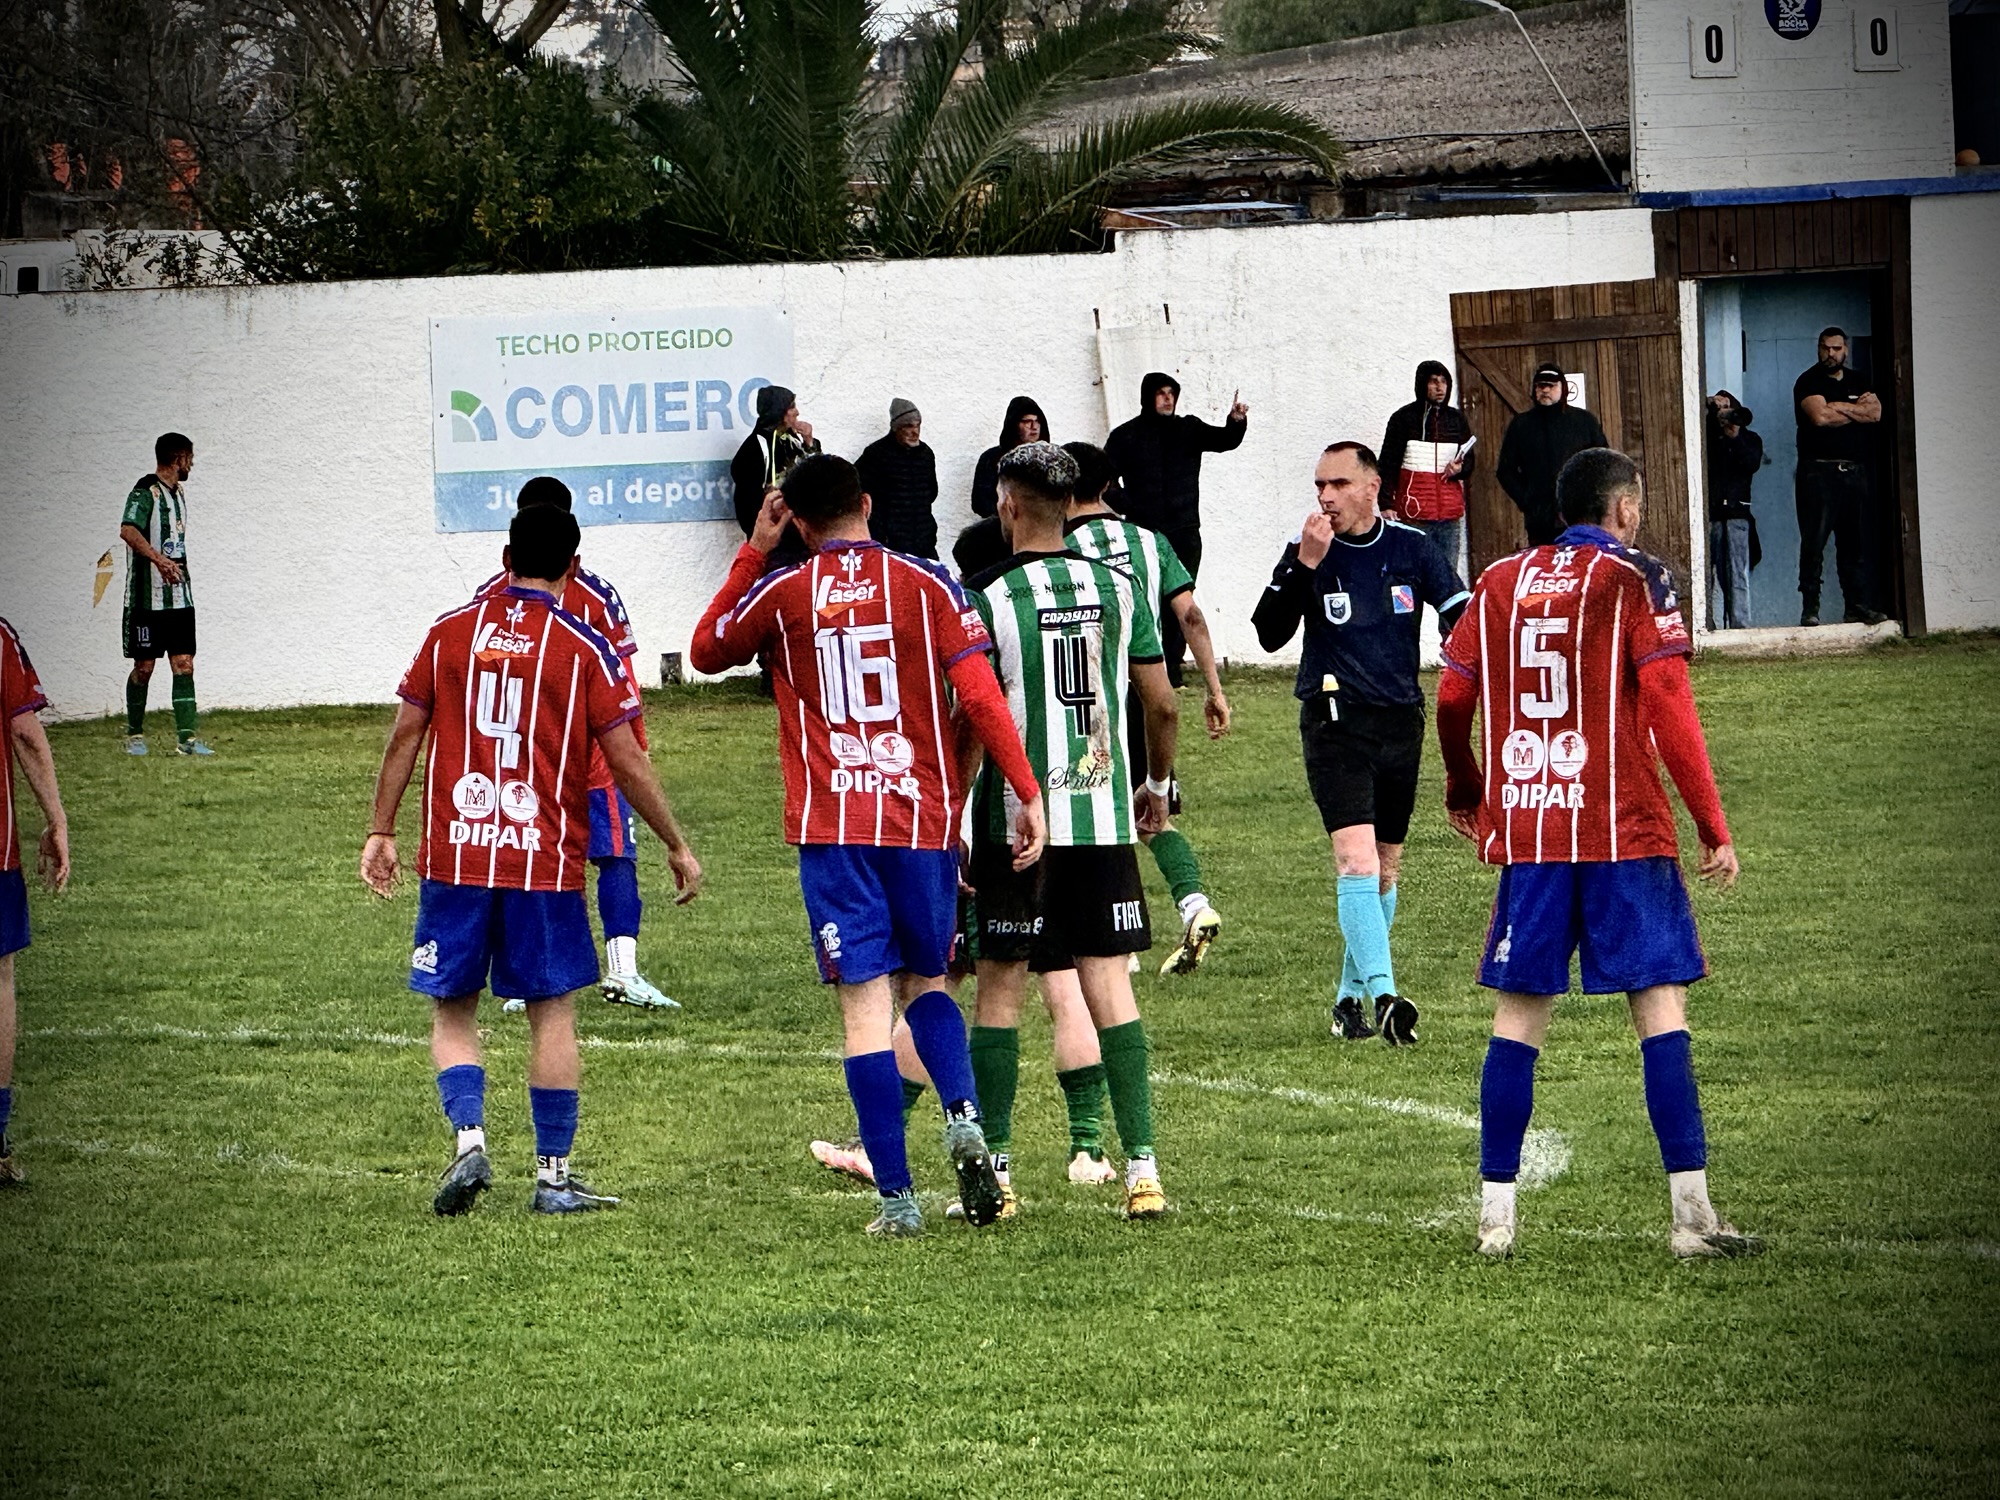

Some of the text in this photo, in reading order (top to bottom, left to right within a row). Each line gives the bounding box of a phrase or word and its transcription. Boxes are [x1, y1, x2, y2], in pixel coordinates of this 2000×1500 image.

[1705, 25, 1723, 63] 0
[1870, 18, 1888, 56] 0
[496, 327, 733, 356] TECHO PROTEGIDO
[588, 479, 613, 506] al
[624, 477, 737, 508] deport
[814, 622, 901, 725] 16
[1052, 634, 1097, 738] 4
[1519, 617, 1569, 719] 5
[475, 670, 523, 770] 4
[831, 768, 923, 801] DIPAR
[1501, 782, 1587, 810] DIPAR
[448, 819, 542, 852] DIPAR
